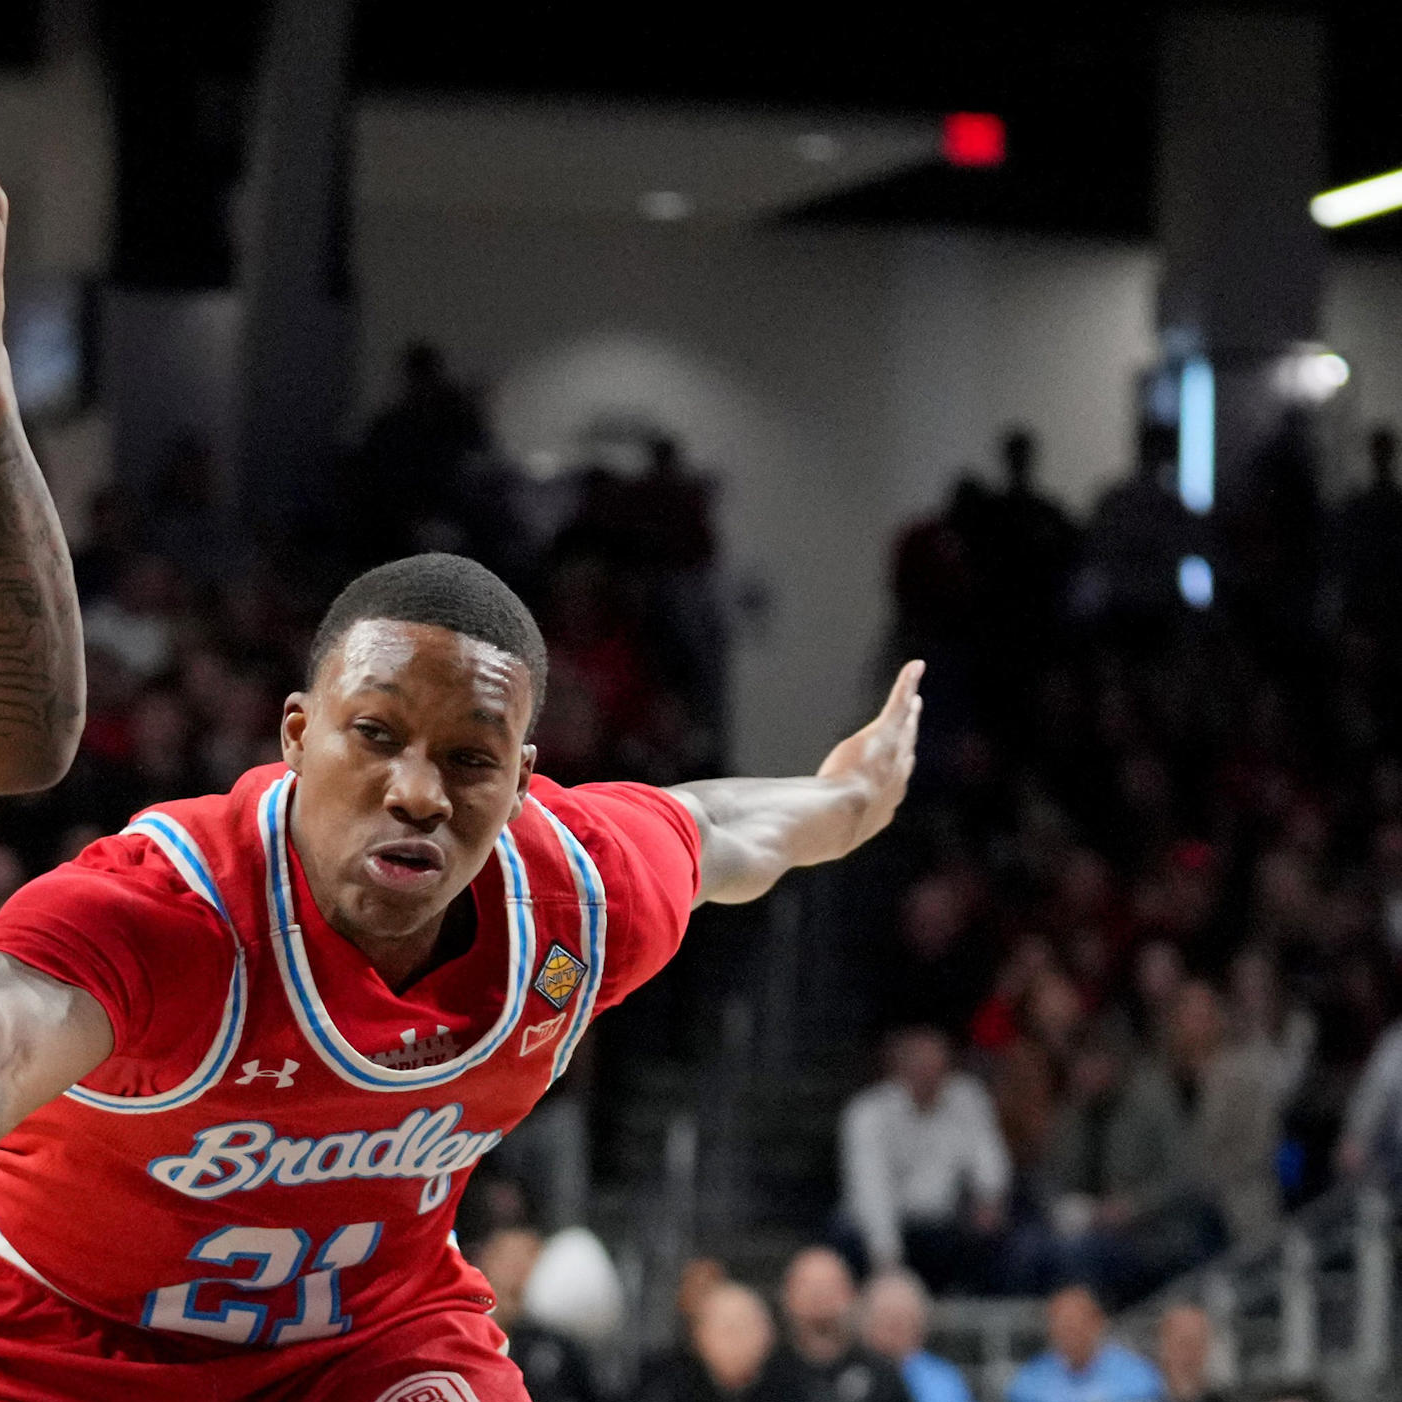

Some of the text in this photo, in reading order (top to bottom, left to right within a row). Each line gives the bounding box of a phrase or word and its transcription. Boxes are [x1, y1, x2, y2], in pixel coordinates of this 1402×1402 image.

[545, 966, 576, 988] NIT
[148, 1103, 502, 1214] Bradley
[141, 1220, 384, 1345] 21
